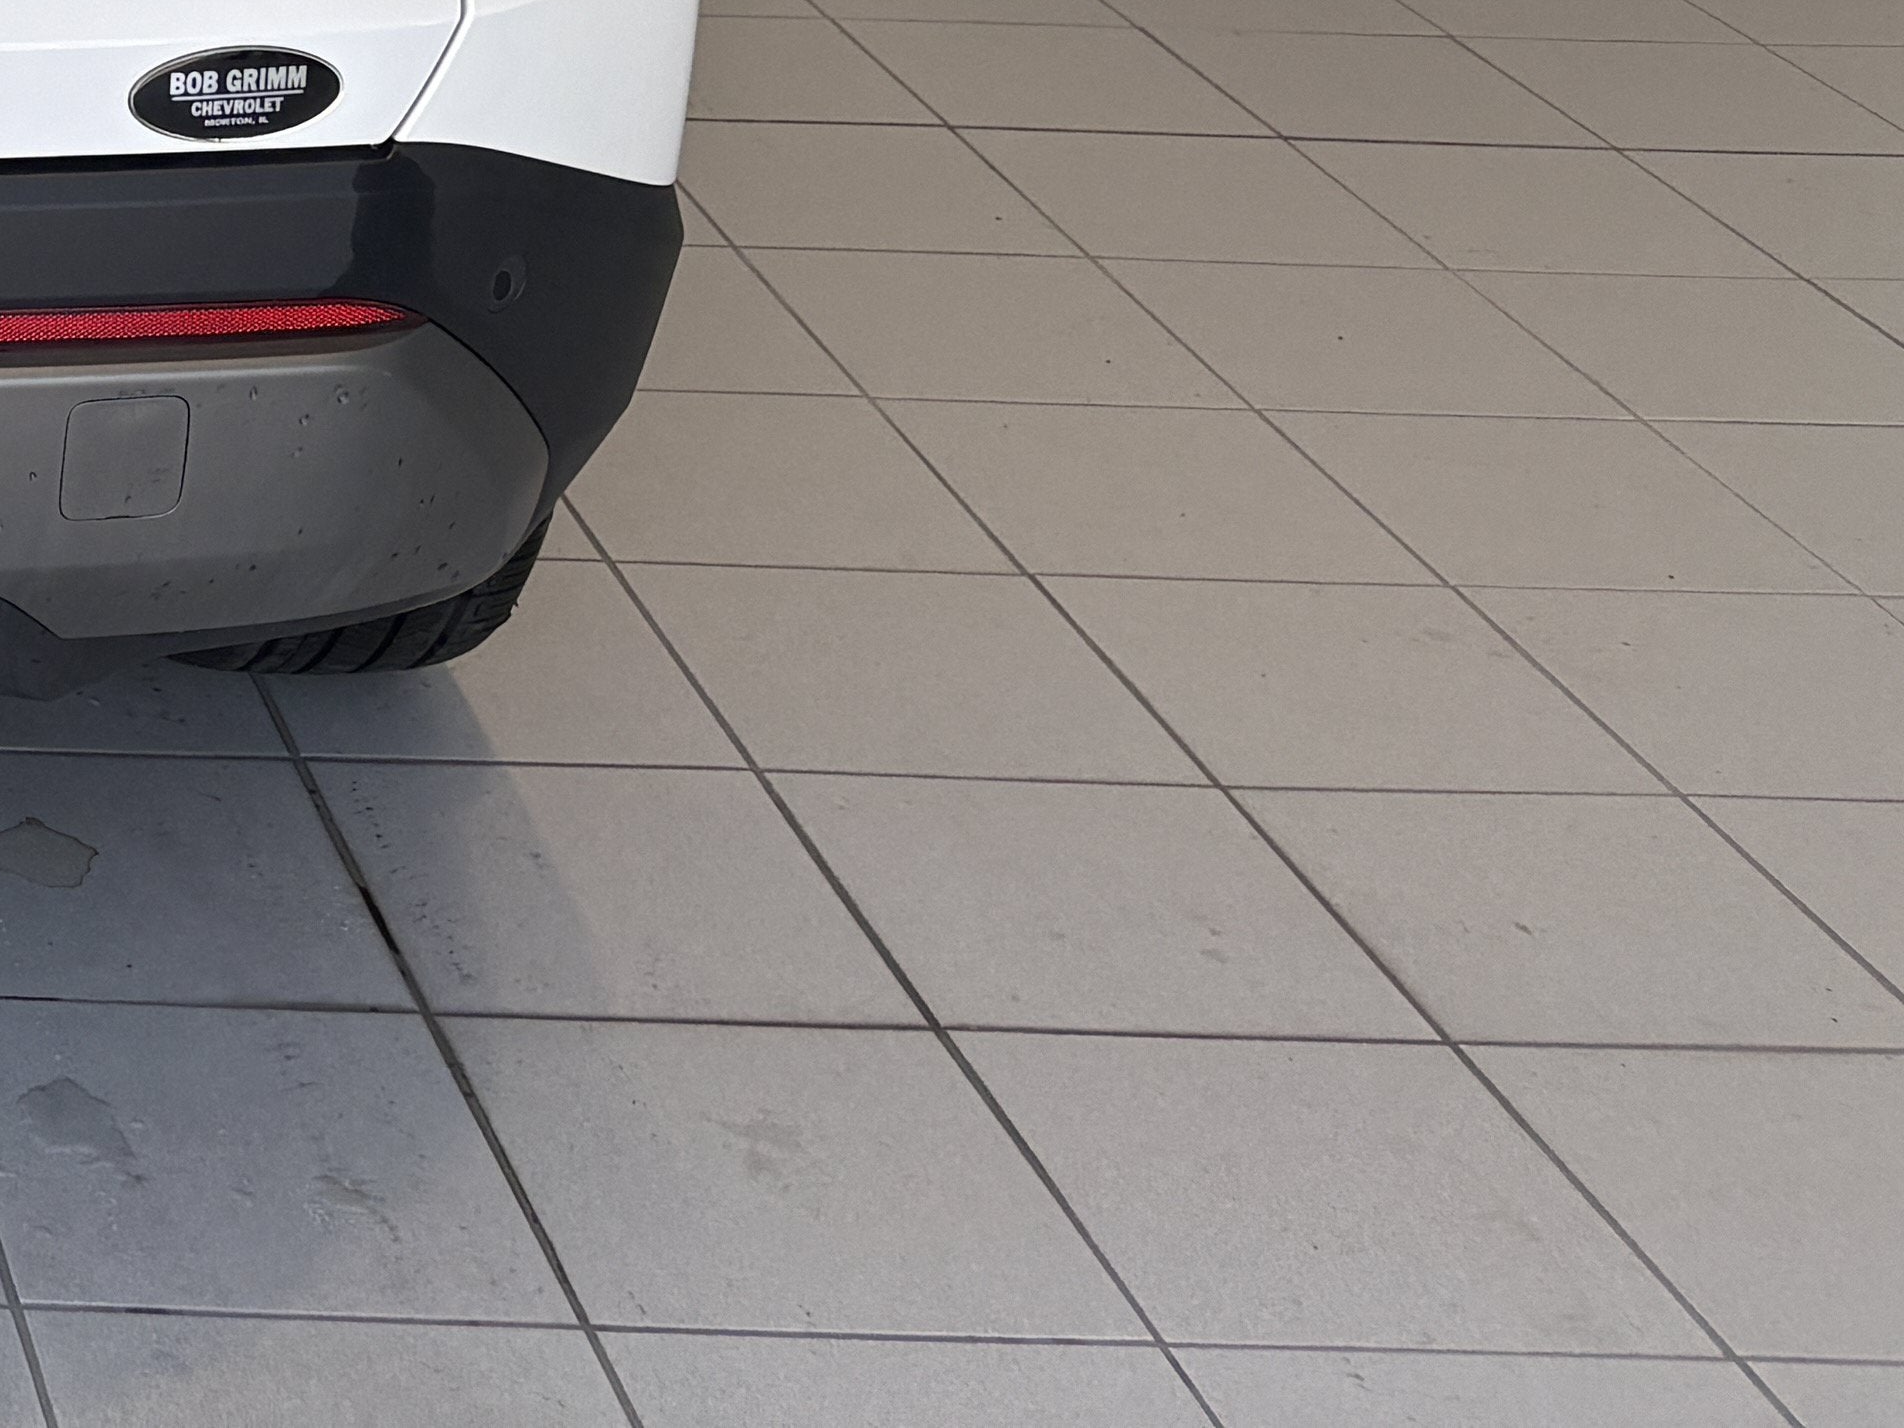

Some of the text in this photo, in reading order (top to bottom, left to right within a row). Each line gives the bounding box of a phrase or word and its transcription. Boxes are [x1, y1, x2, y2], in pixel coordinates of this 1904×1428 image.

[169, 64, 308, 96] BOB GRIMM
[191, 96, 285, 117] CHEVROLET
